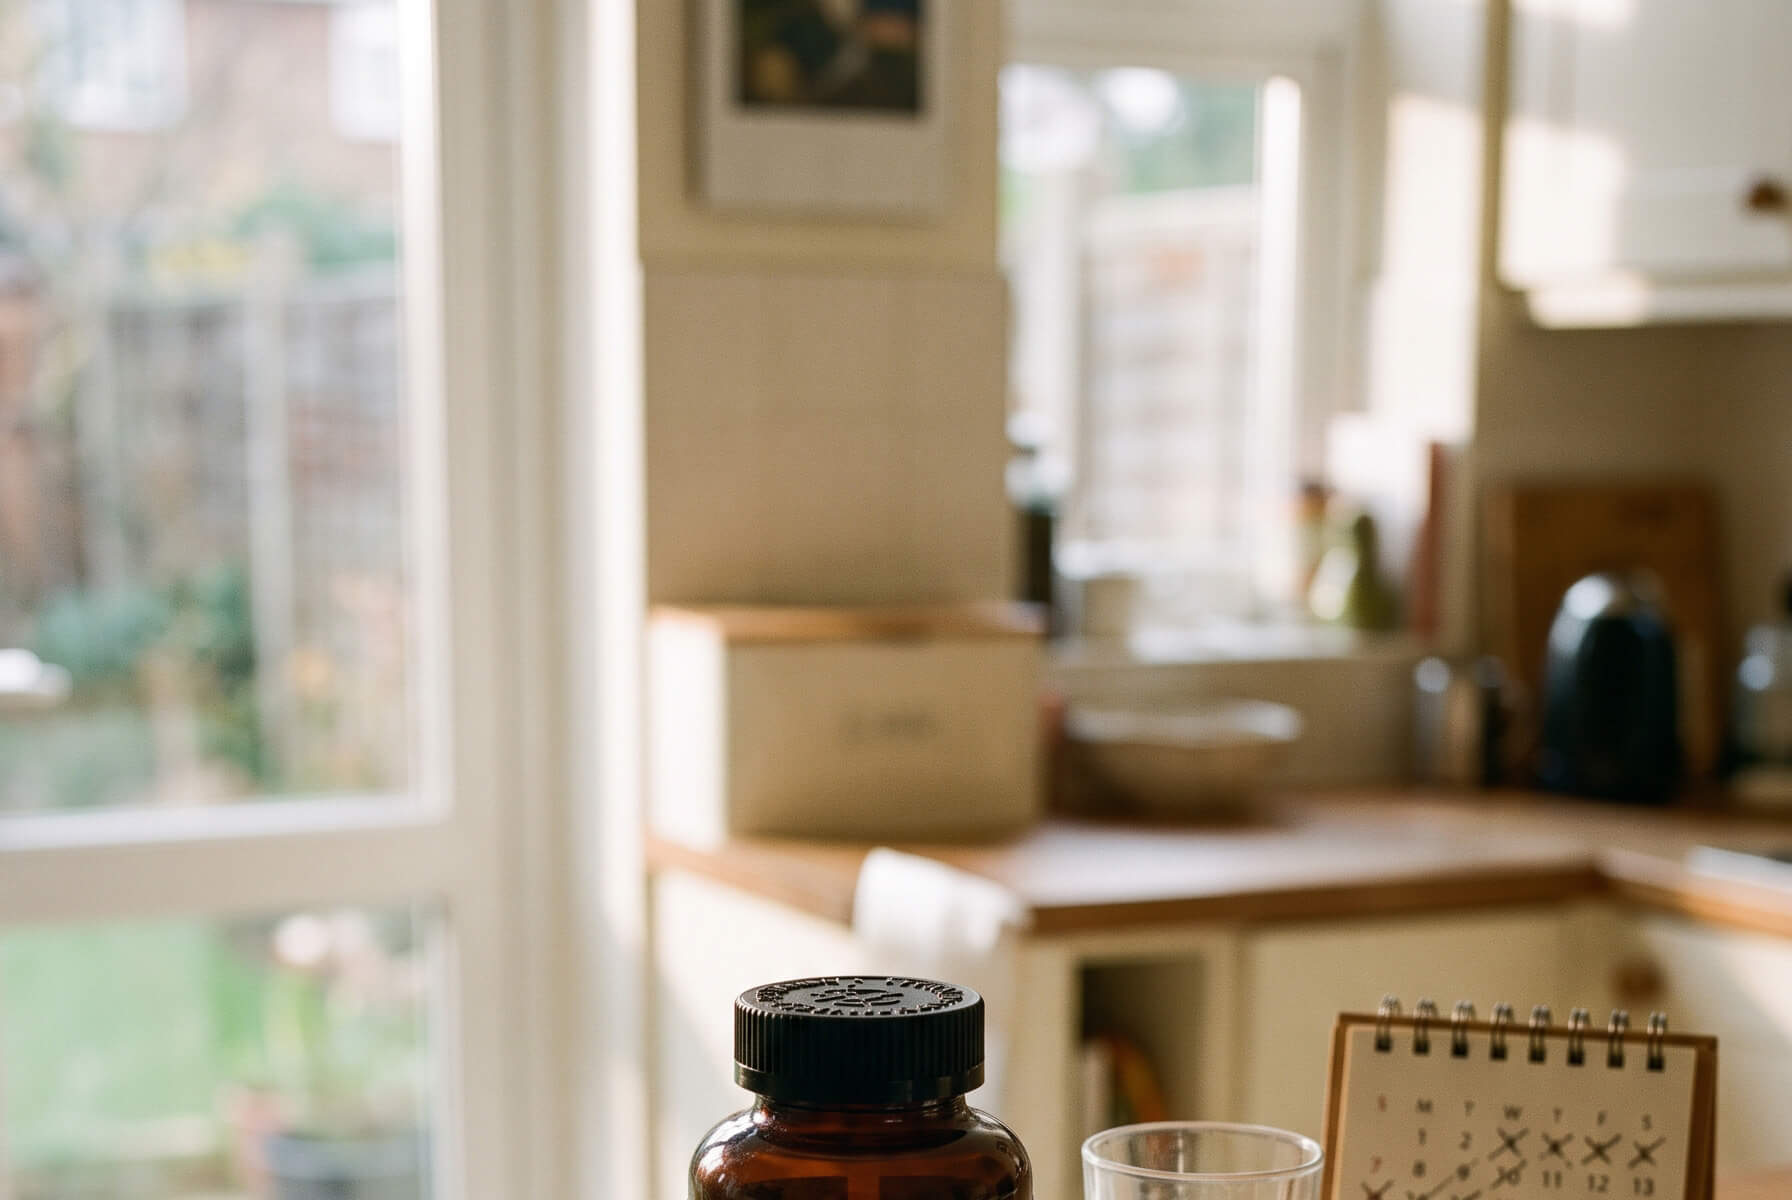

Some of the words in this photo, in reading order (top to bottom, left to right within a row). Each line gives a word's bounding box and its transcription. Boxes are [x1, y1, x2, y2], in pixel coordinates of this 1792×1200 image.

[1543, 1170, 1562, 1189] 11
[1588, 1173, 1609, 1192] 12
[1633, 1176, 1654, 1197] 13
